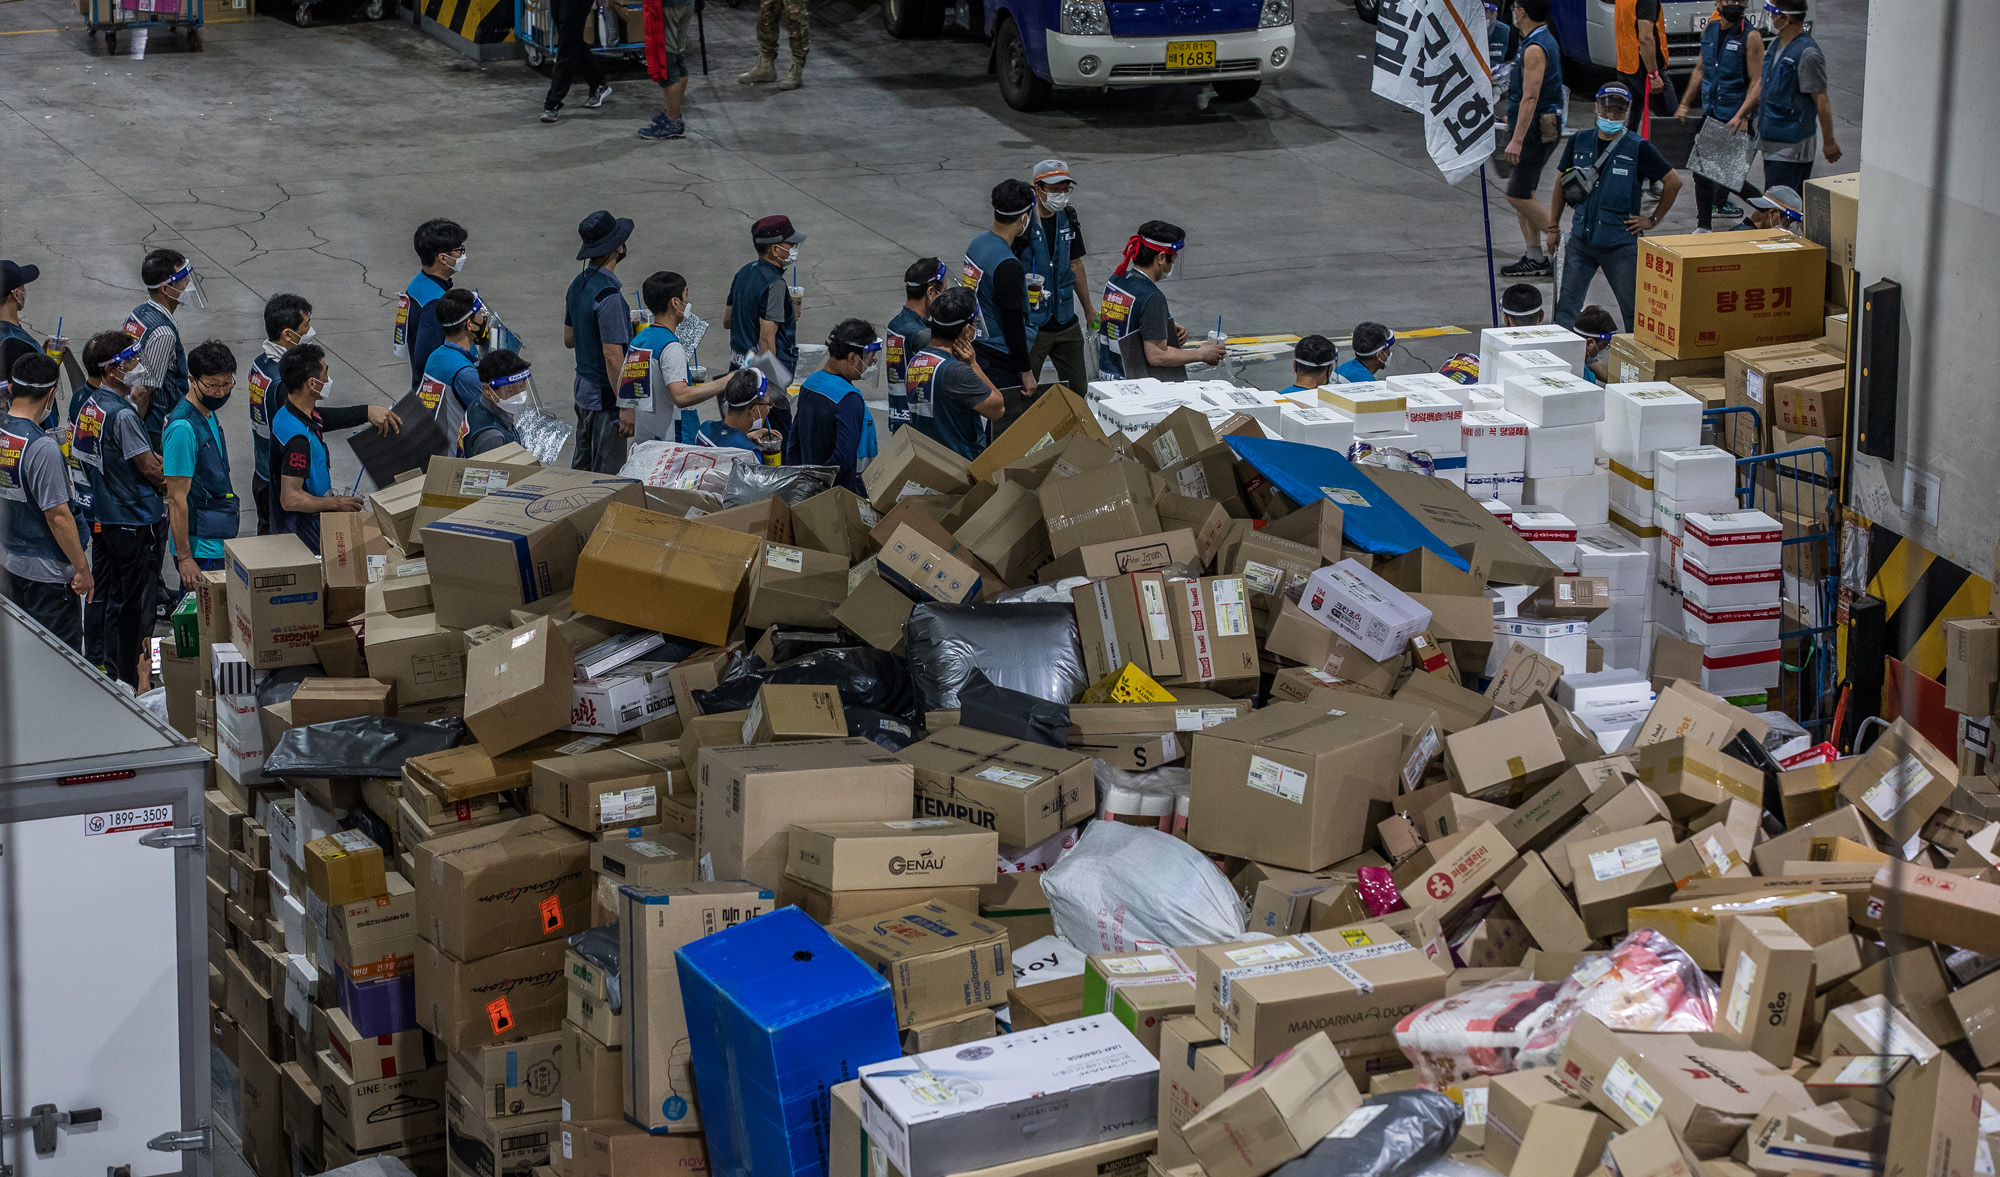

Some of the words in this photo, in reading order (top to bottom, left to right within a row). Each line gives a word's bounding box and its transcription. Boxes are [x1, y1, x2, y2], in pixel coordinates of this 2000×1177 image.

[1179, 51, 1213, 66] 1683
[1645, 252, 1674, 278] 탕용기
[1717, 286, 1793, 313] 탕용기
[290, 453, 307, 468] 85
[1249, 530, 1271, 542] DIVA
[1272, 537, 1318, 555] DASHING
[202, 587, 212, 628] HUGGIES
[272, 632, 320, 644] HUGGIES
[1133, 746, 1148, 768] S
[109, 807, 169, 826] 1899-3509
[914, 794, 996, 831] TEMPUR
[889, 855, 946, 876] GENAU
[1287, 1011, 1364, 1034] MANDARINA
[1383, 1004, 1416, 1019] DUCK
[356, 1084, 380, 1098] LINE
